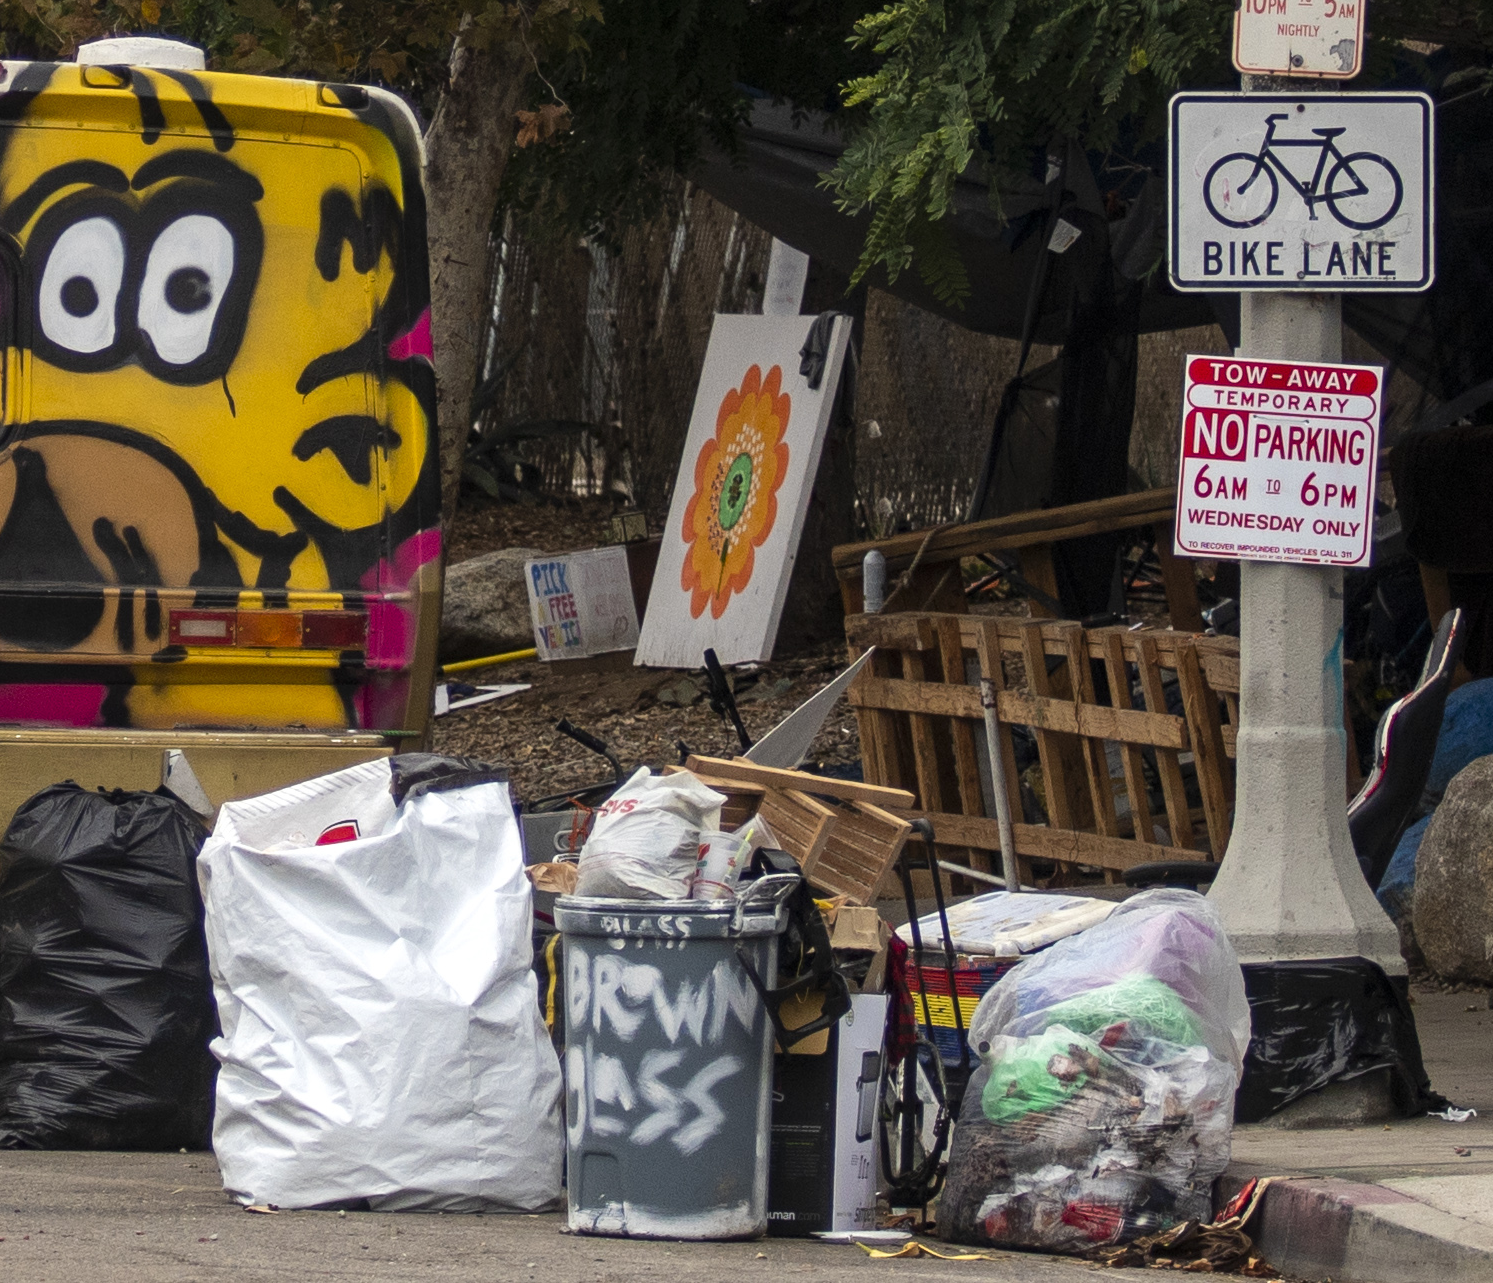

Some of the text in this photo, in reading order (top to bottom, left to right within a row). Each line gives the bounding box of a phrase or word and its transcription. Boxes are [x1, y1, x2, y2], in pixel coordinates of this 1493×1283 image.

[1277, 23, 1320, 37] NIGHTLY
[1203, 241, 1396, 276] BIKE LANE
[1214, 390, 1349, 413] TEMPORARY
[1193, 412, 1364, 465] NO PARKING
[1194, 464, 1357, 508] 6AM TO 6PM
[1188, 509, 1360, 537] WEDNESDAY ONLY
[1201, 542, 1234, 551] RECOVER
[1237, 544, 1280, 553] IMPOUNDED
[1283, 547, 1317, 556] VEHICLES
